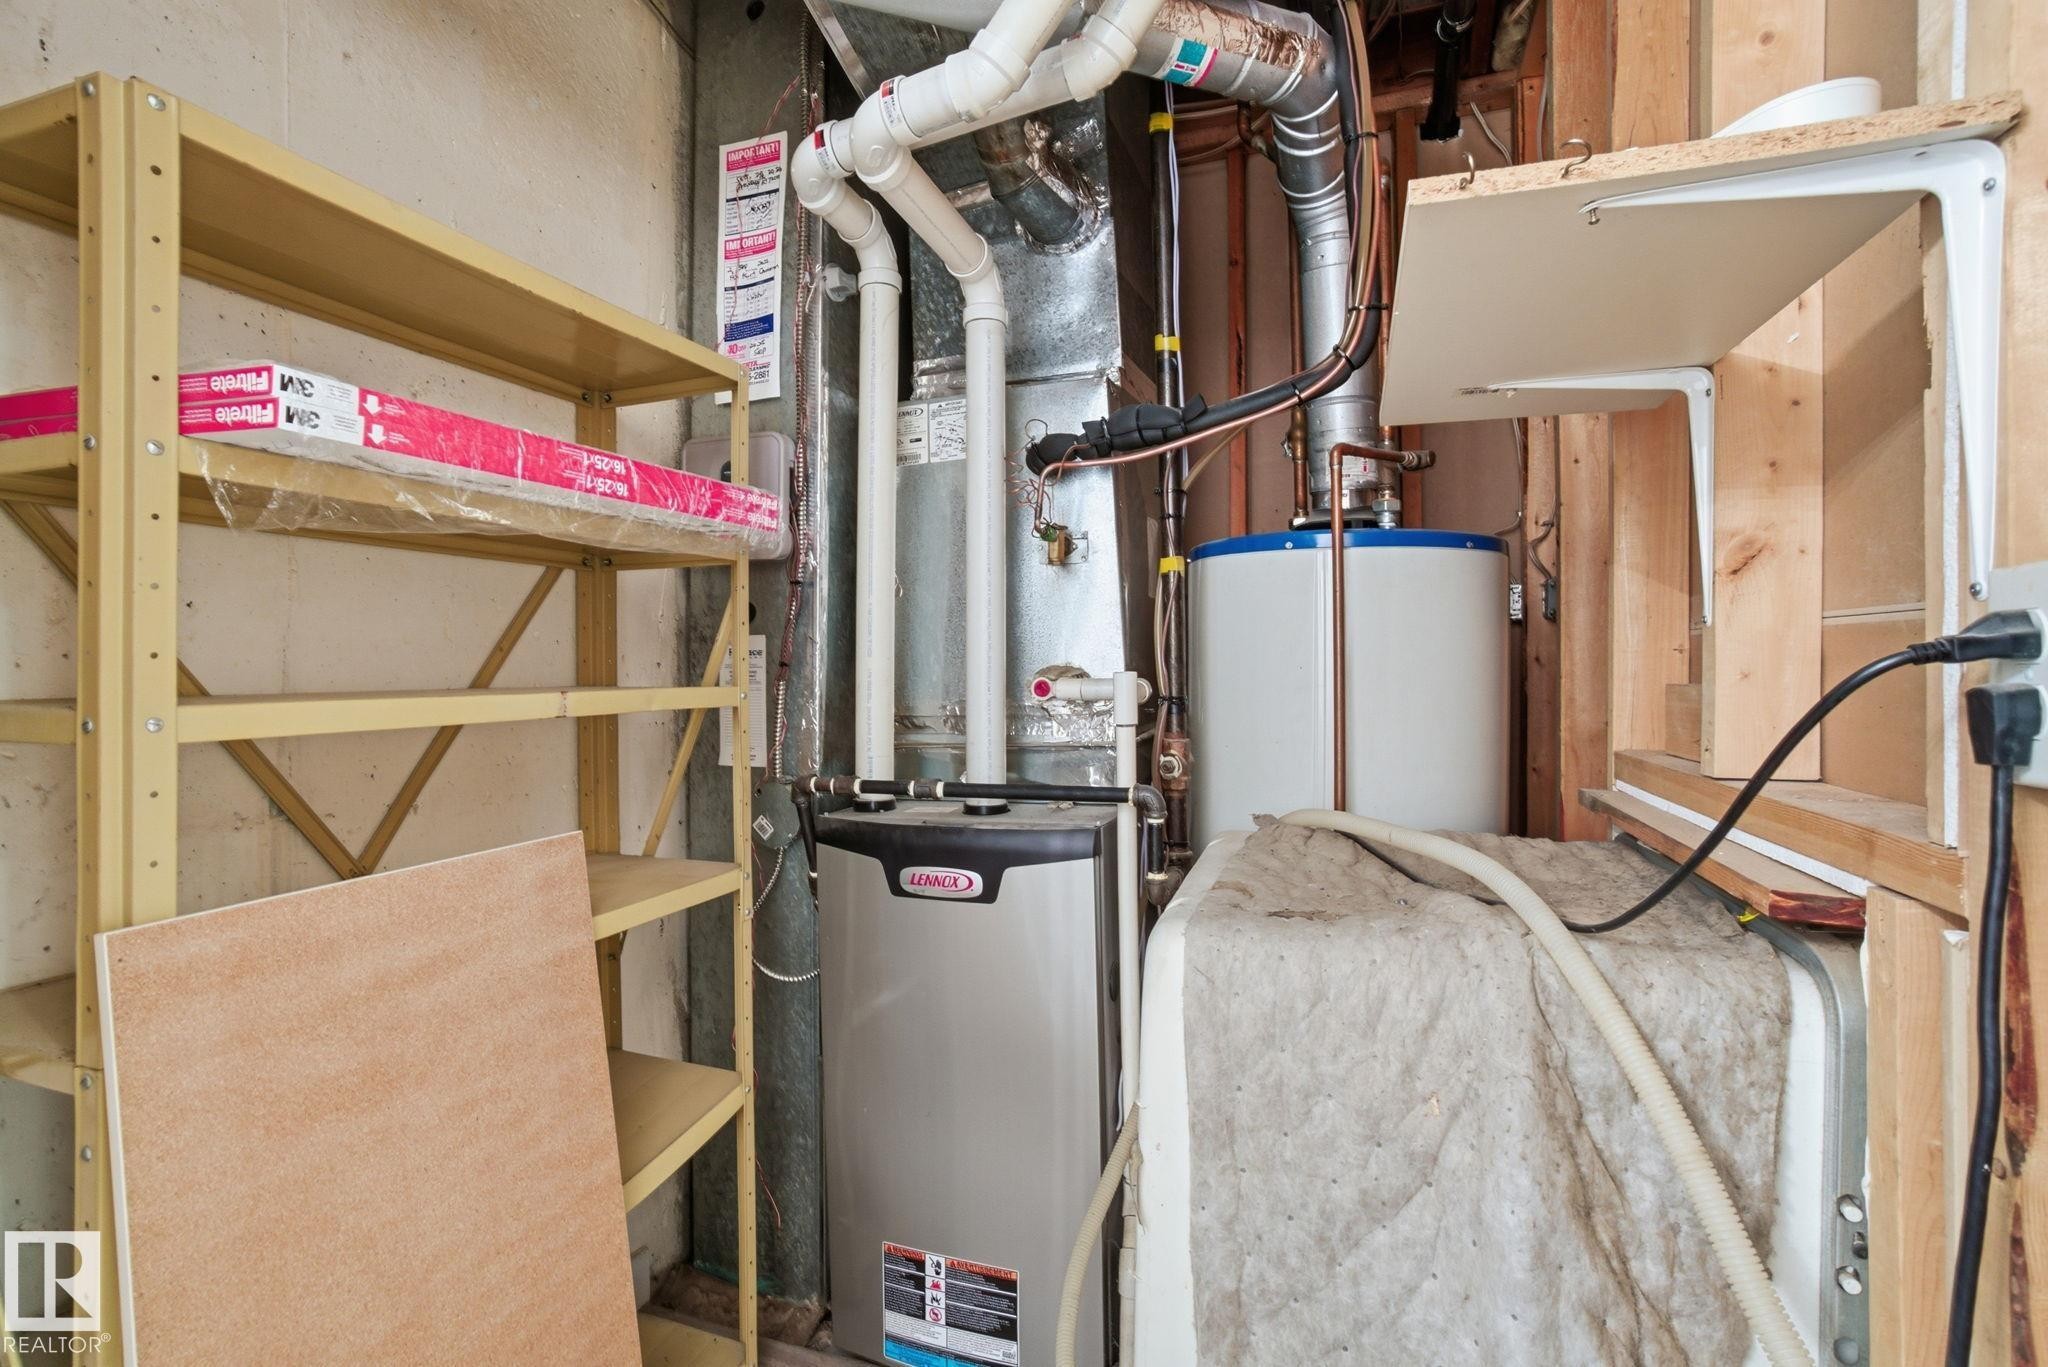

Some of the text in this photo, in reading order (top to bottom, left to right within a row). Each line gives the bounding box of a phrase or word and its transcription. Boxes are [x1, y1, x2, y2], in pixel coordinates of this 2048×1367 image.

[210, 370, 269, 395] Filtrete
[214, 402, 275, 426] Filtrete
[583, 451, 626, 476] 16x25x1
[586, 474, 629, 497] 16x25x1
[910, 873, 961, 889] LENNOX
